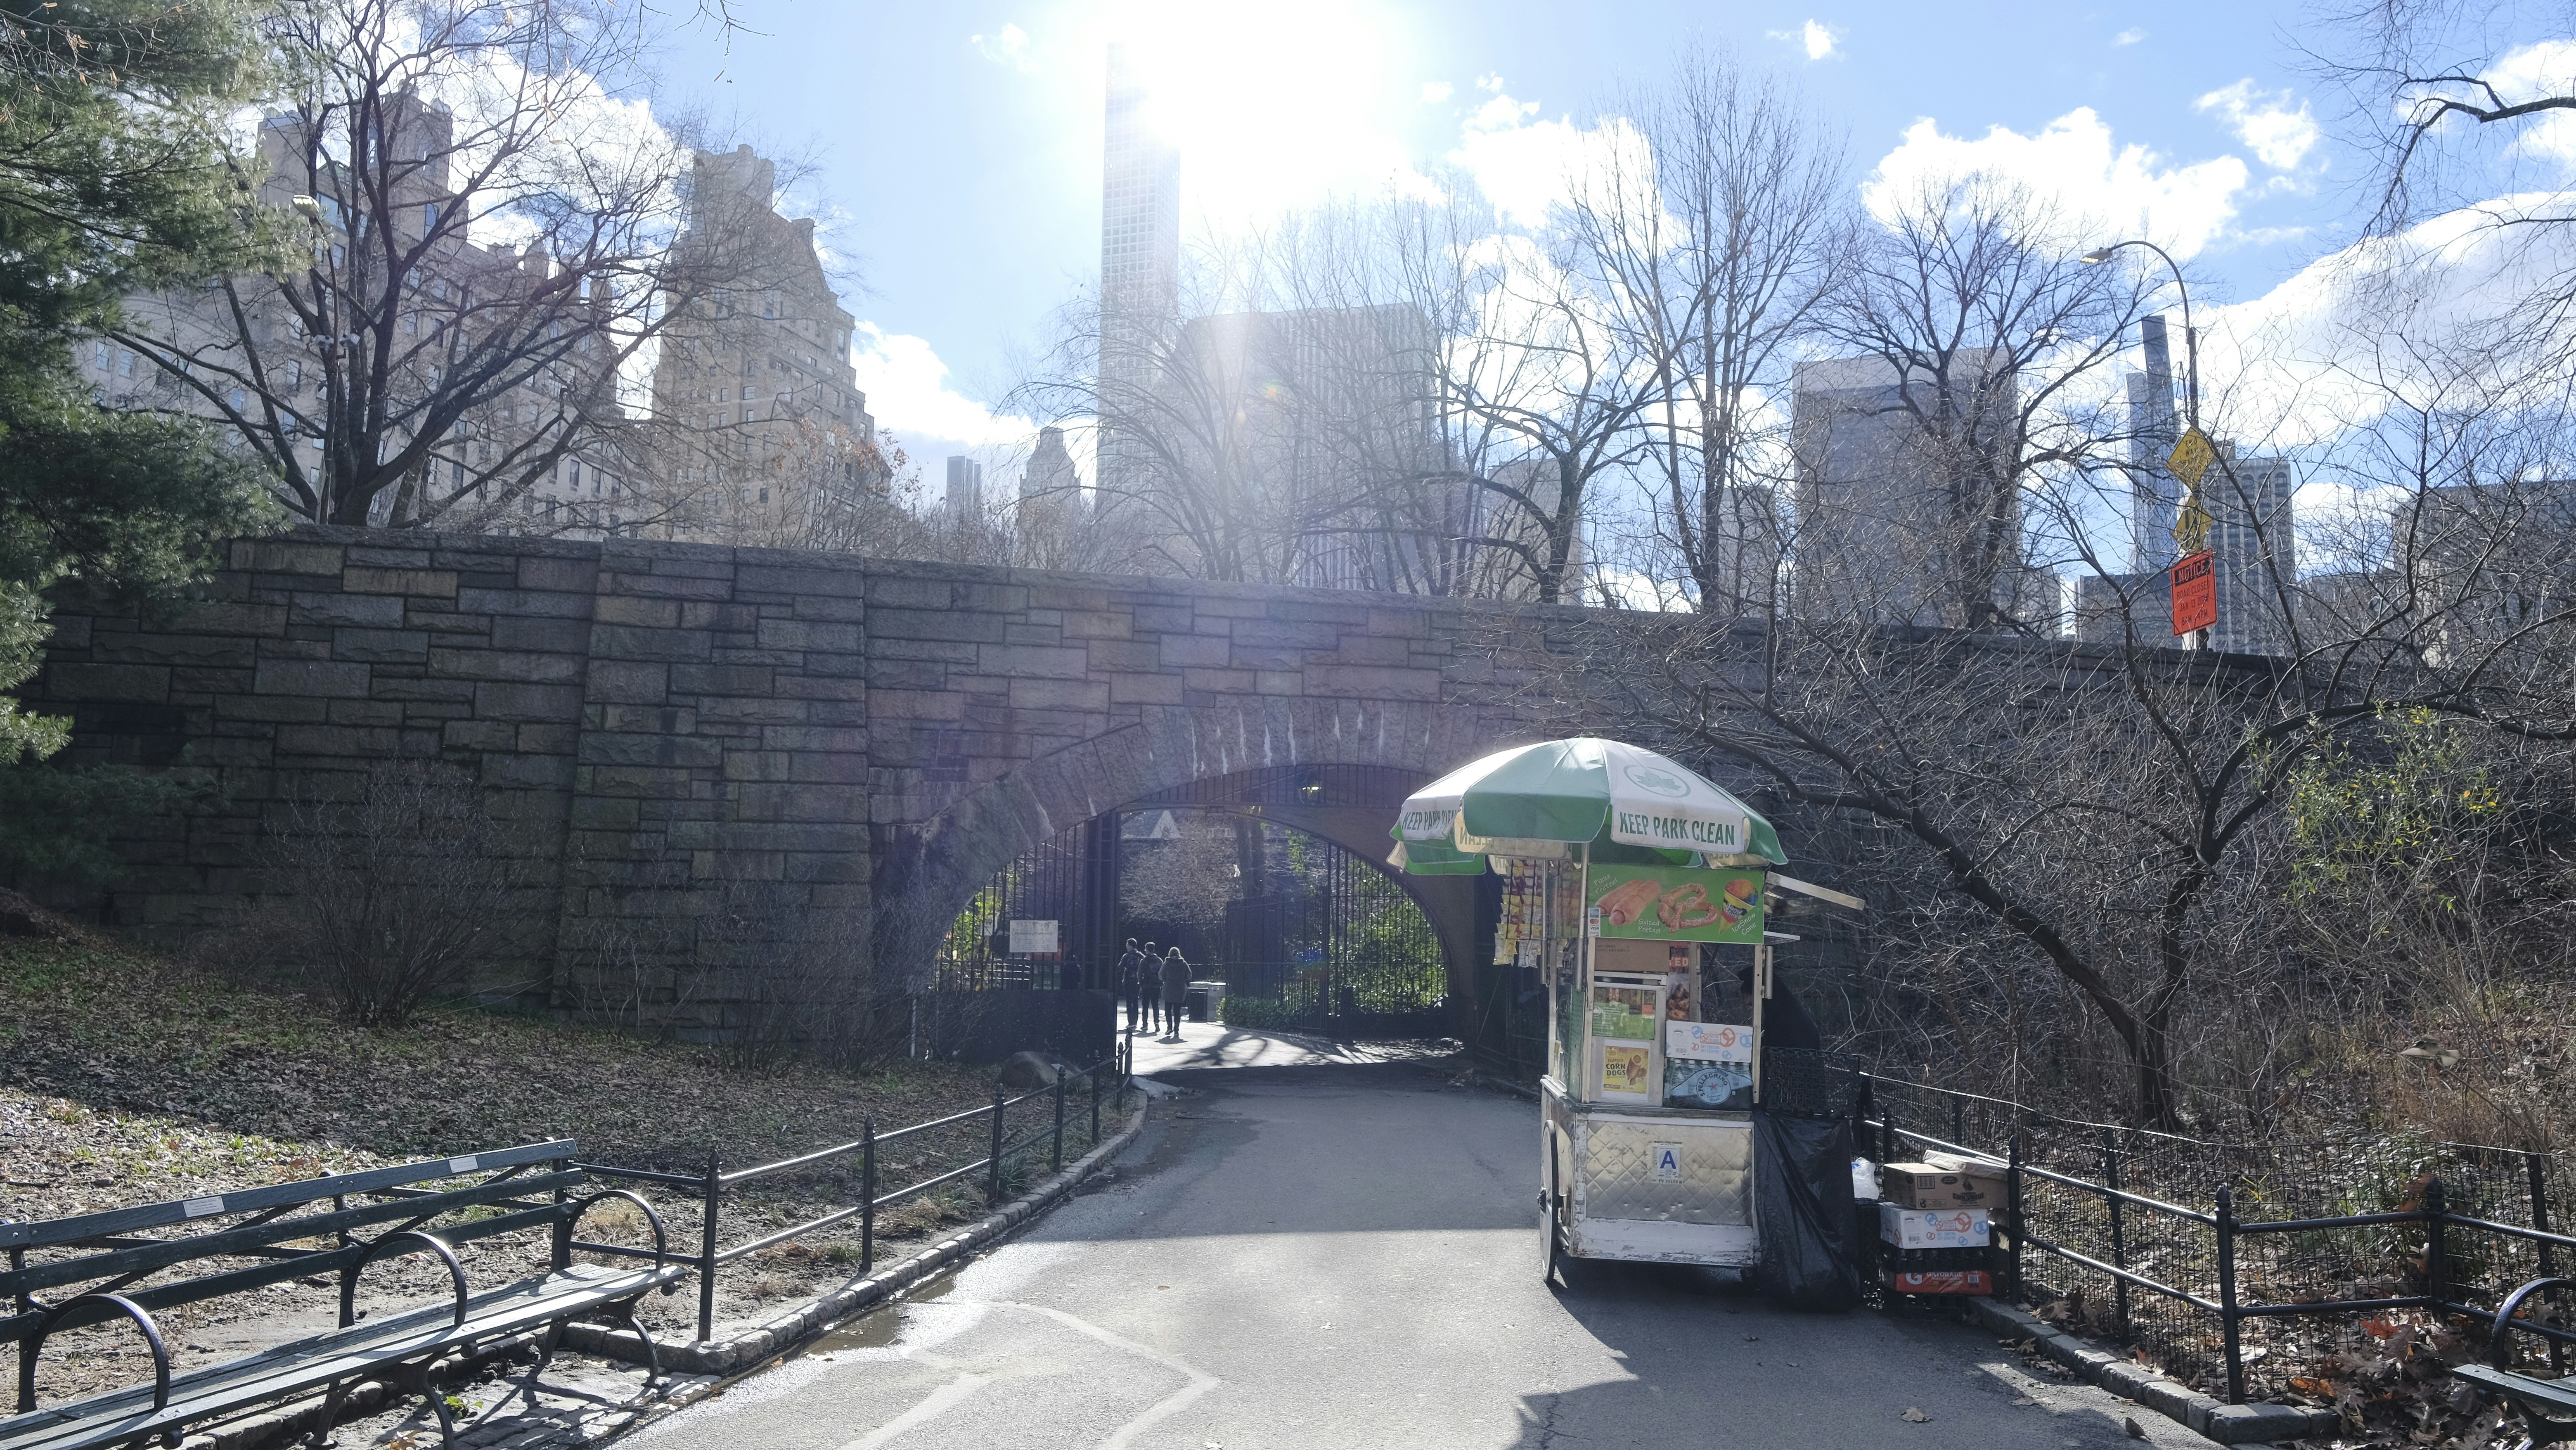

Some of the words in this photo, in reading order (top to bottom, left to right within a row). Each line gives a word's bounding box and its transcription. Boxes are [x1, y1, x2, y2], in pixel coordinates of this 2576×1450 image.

[2178, 559, 2206, 582] NOTICE
[2177, 587, 2190, 599] ROAD
[2191, 581, 2210, 594] CLOSED
[2180, 601, 2189, 611] JAN
[2191, 599, 2196, 608] 13
[1402, 811, 1423, 831] KEEP
[1619, 812, 1649, 835] KEEP
[1653, 816, 1689, 840] PARK
[1692, 820, 1735, 846] CLEAN
[1593, 874, 1611, 886] Pizza
[1594, 878, 1618, 895] Pretzel
[1741, 923, 1757, 935] Cone
[1660, 1150, 1676, 1169] A
